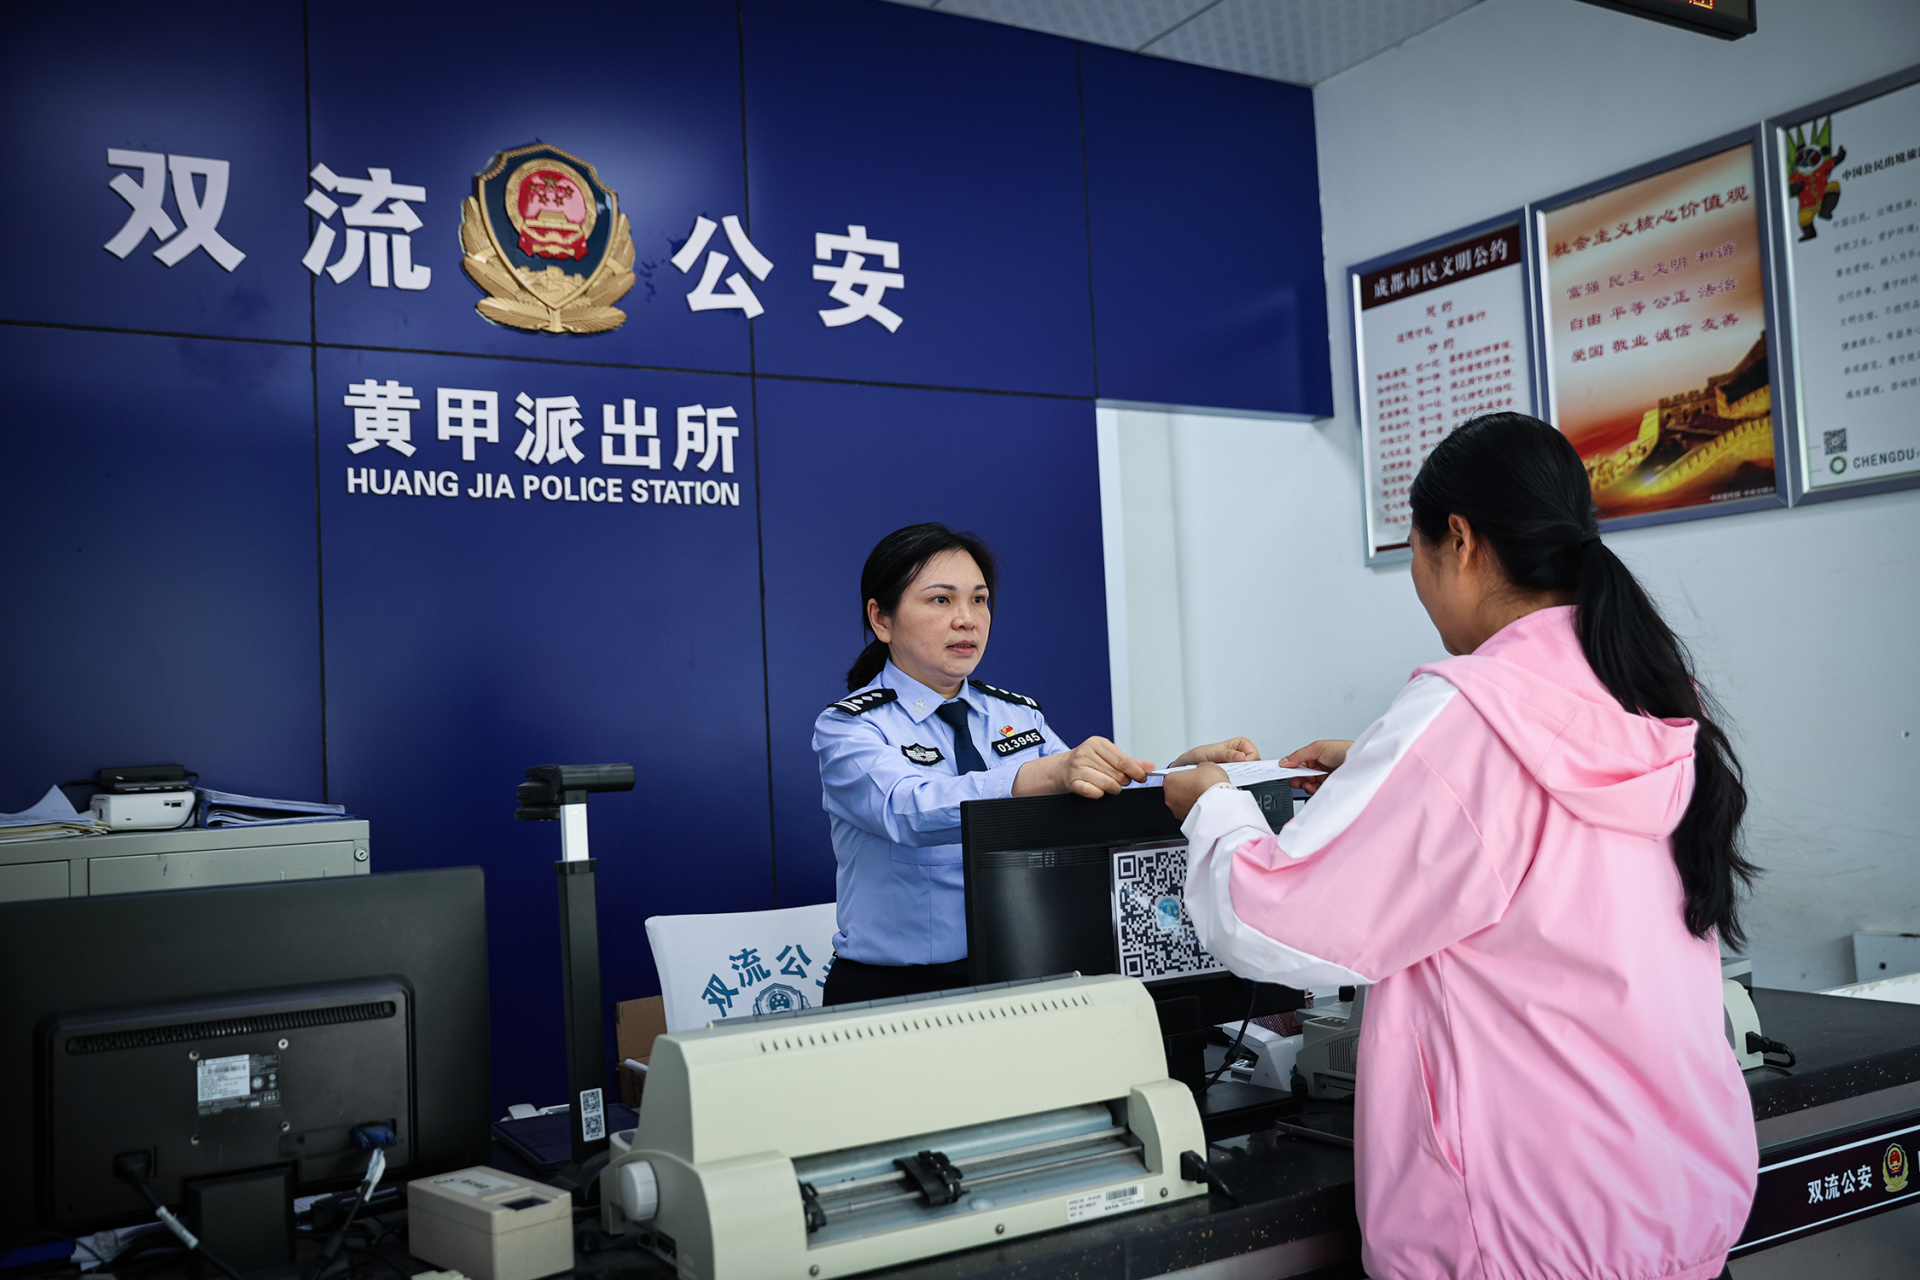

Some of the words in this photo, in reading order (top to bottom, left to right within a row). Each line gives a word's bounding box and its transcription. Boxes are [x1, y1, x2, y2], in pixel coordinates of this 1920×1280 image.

[1842, 146, 1920, 181] 中国公民出境旅
[103, 147, 431, 291] 双流
[671, 214, 905, 333] 公安
[1552, 184, 1749, 258] 社会主义核心价值观
[1374, 237, 1507, 298] 成都市民文明公约
[1567, 281, 1600, 300] 富强
[1609, 269, 1645, 289] 民主
[1651, 256, 1688, 277] 文明
[1696, 242, 1736, 264] 和谐
[1569, 313, 1602, 331] 自由
[1610, 301, 1646, 320] 平等
[1653, 289, 1690, 309] 公正
[1697, 277, 1738, 298] 法治
[1570, 345, 1603, 363] 爱国
[1612, 335, 1648, 353] 敬业
[1654, 324, 1692, 343] 诚信
[1701, 312, 1739, 332] 友善
[344, 379, 740, 473] 黄甲派出所
[1853, 446, 1915, 469] CHENGDU
[347, 467, 458, 498] HUANG
[467, 473, 516, 501] JIA
[523, 475, 623, 503] POLICE
[631, 479, 740, 507] STATION
[997, 731, 1041, 754] 013945
[1807, 1164, 1873, 1204] 双流公安
